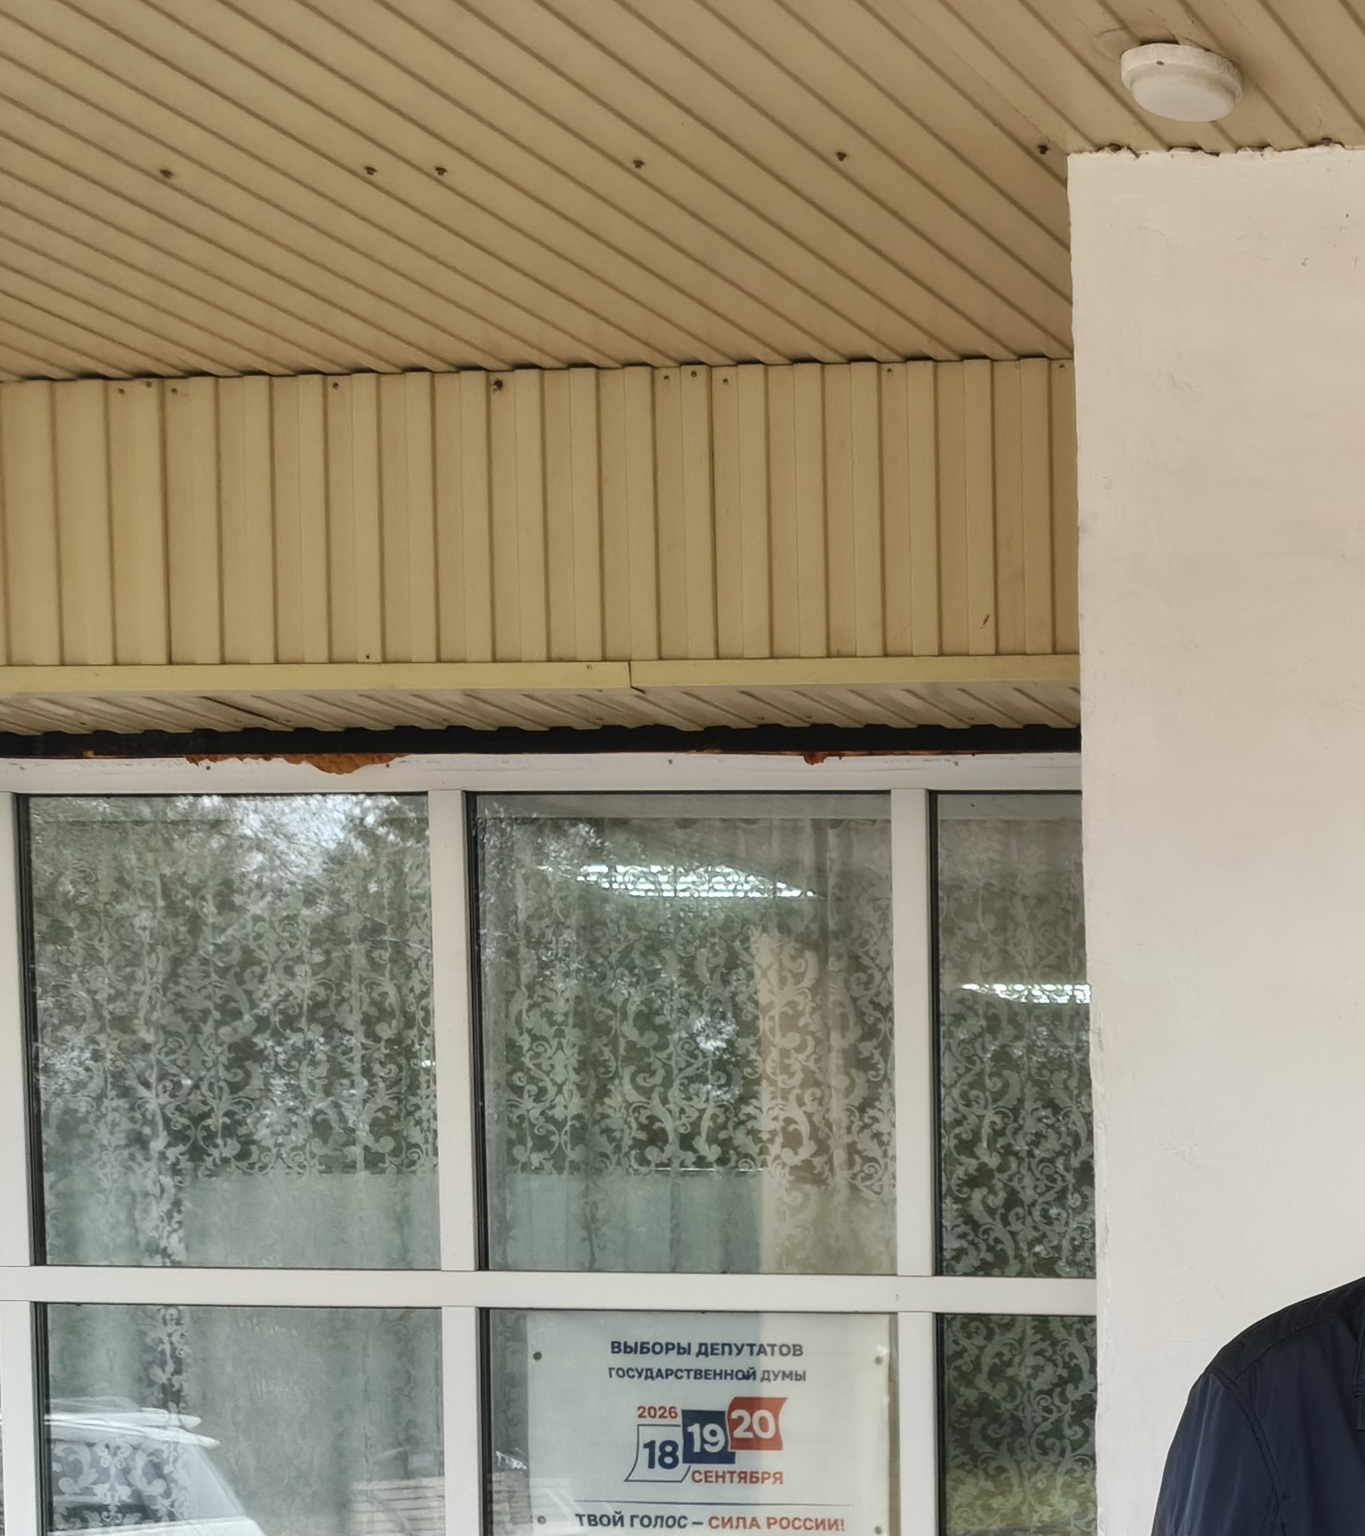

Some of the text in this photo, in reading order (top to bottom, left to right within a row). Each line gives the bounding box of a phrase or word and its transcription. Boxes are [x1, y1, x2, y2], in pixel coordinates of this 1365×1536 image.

[610, 1340, 805, 1358] ВЫБОРЫ ДЕПУТАТОВ
[608, 1366, 807, 1384] ГОСУДАРСТВЕННОЙ ДУМЫ
[637, 1405, 679, 1420] 2026
[730, 1408, 776, 1440] 20
[687, 1422, 726, 1454] 19
[643, 1439, 680, 1471] 18
[691, 1469, 784, 1485] СЕНТЯБРЯ
[575, 1510, 626, 1530] ТВОЙ
[629, 1513, 689, 1530] ГОЛОС
[708, 1514, 761, 1531] СИЛА
[766, 1516, 846, 1533] РОССИИ!
